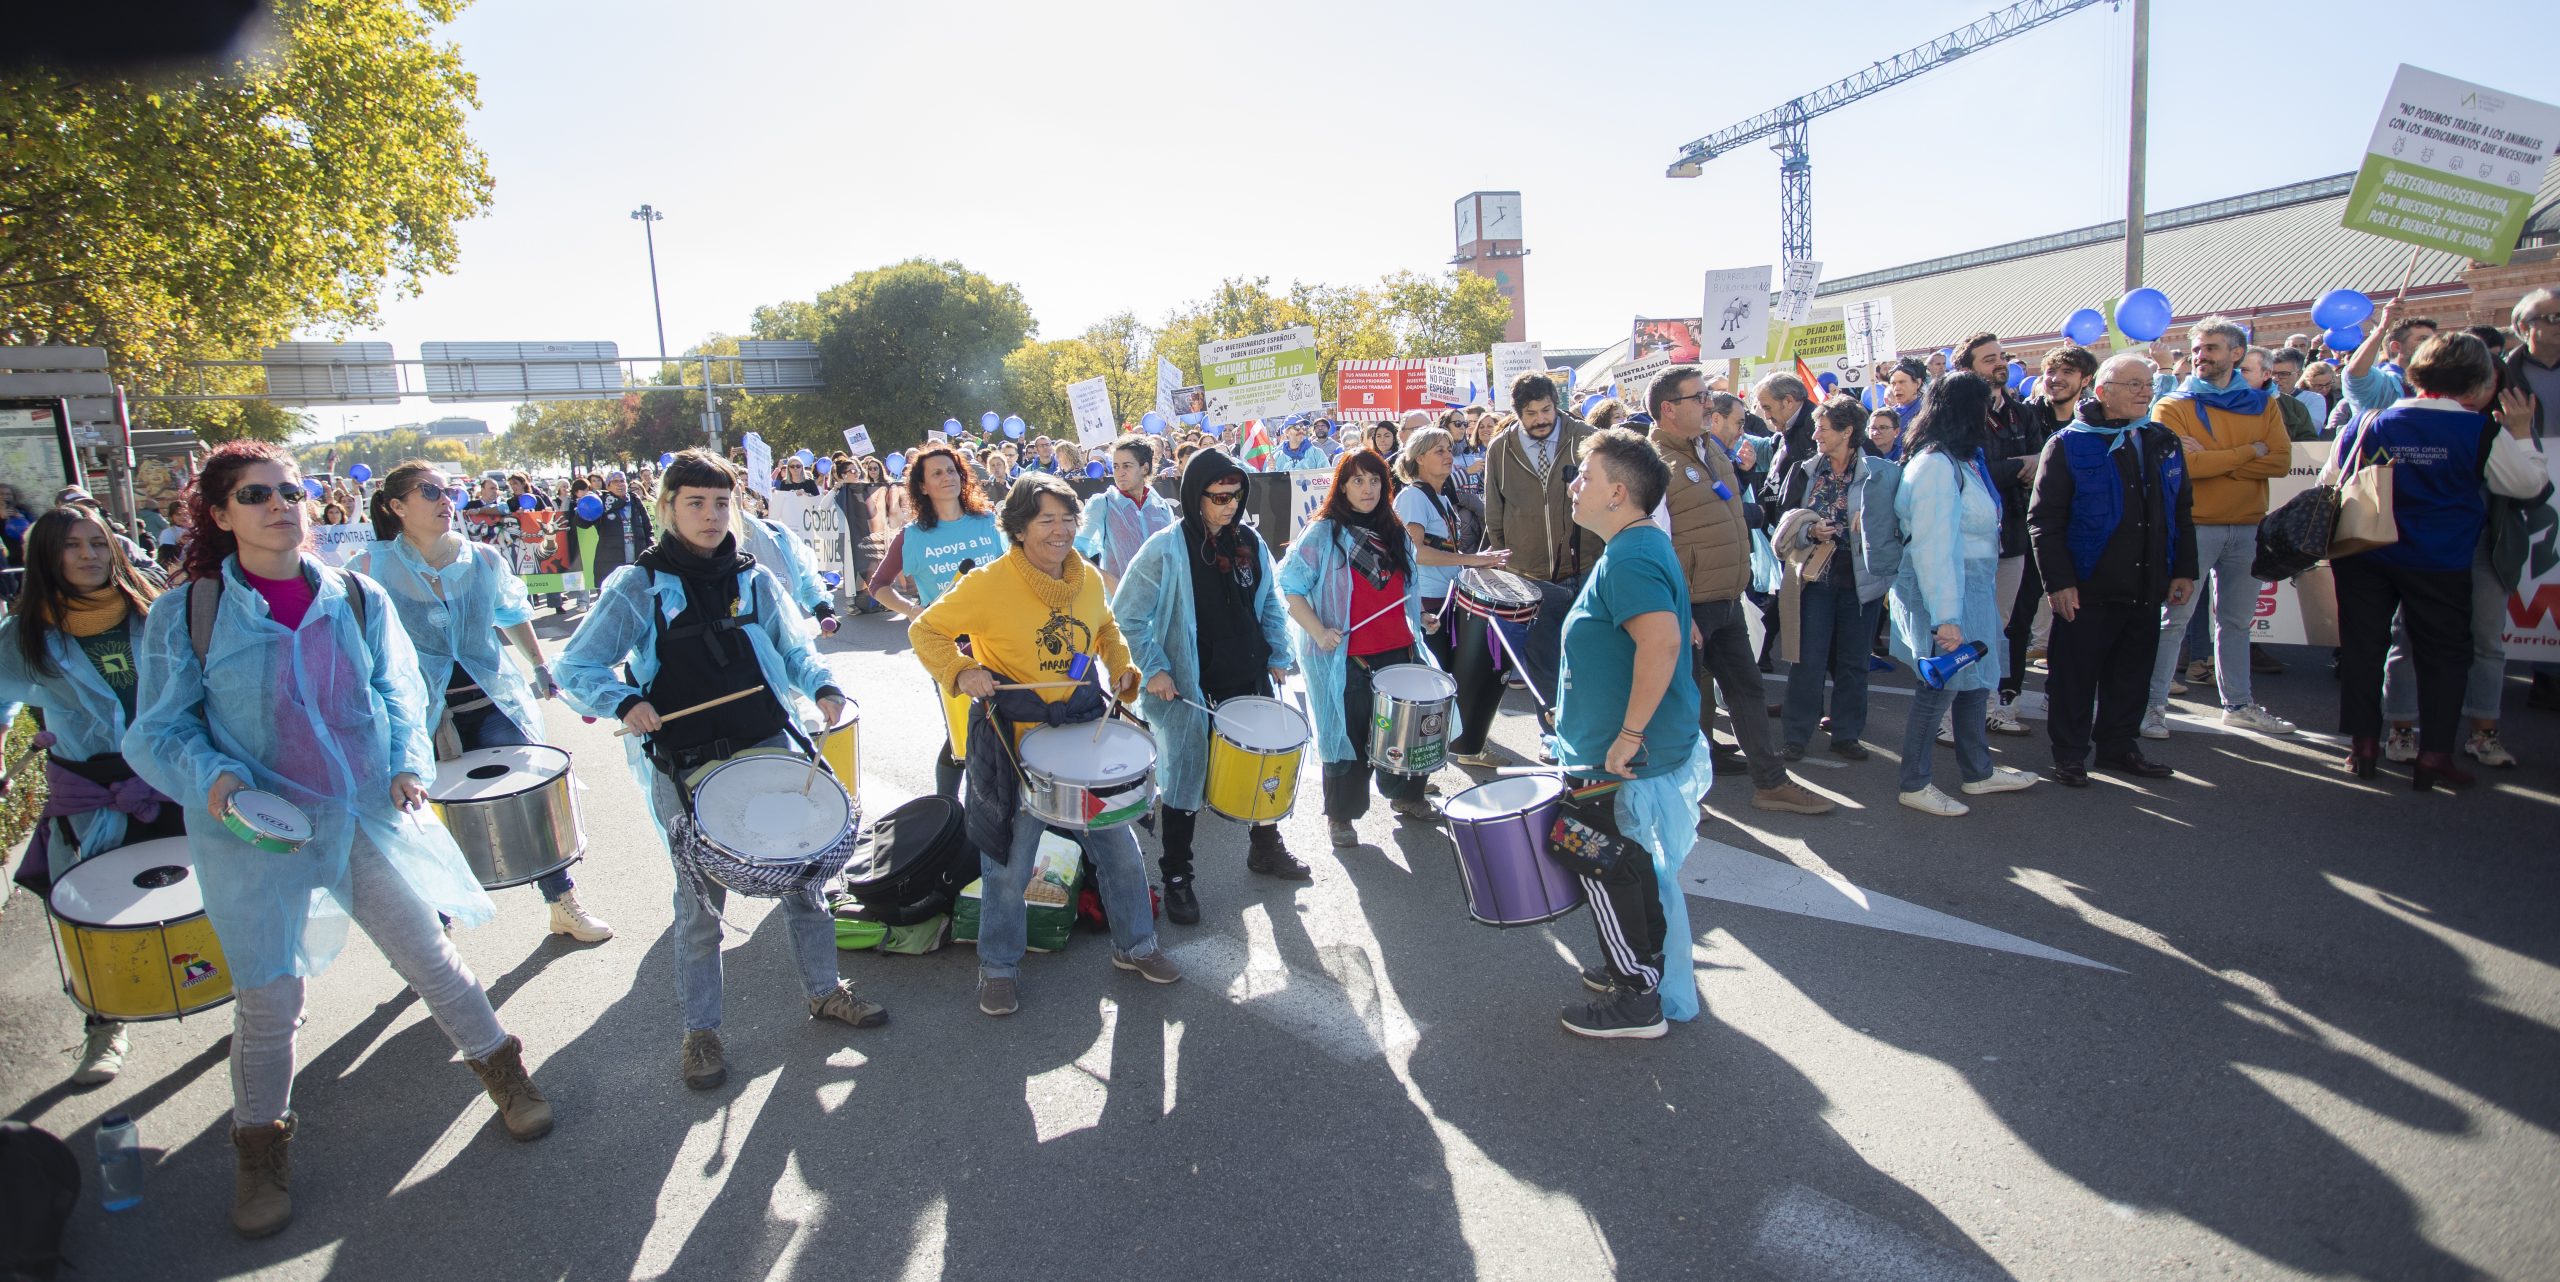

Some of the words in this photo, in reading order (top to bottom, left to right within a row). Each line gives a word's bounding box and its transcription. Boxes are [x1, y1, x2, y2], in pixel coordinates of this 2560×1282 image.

[2388, 117, 2406, 131] CON
[2407, 122, 2422, 135] LOS
[2422, 127, 2481, 151] MEDICAMENTOS
[2480, 141, 2497, 154] QUE
[2415, 107, 2453, 127] PODEMOS
[2452, 116, 2482, 134] TRATAR
[2482, 125, 2489, 135] A
[2489, 127, 2504, 140] LOS
[2504, 131, 2543, 150] ANIMALES
[2376, 192, 2393, 208] POR
[2396, 197, 2443, 219] NUESTROS
[2443, 208, 2491, 231] PACIENTES
[2491, 221, 2500, 232] Y
[2368, 210, 2387, 225] POR
[2388, 215, 2399, 228] EL
[2400, 217, 2450, 240] BIENESTAR
[2449, 229, 2460, 242] DE
[2460, 231, 2493, 250] TODOS
[1806, 325, 1828, 336] DEJAD
[1830, 323, 1844, 332] QUE
[1214, 346, 1224, 354] LOS
[1267, 332, 1297, 344] ESPAÑOLES
[1230, 351, 1247, 359] DEBEN
[1248, 348, 1266, 356] ELEGIR
[1266, 344, 1283, 354] ENTRE
[1794, 337, 1808, 347] LOS
[1797, 345, 1834, 356] SALVEMOS
[1214, 362, 1247, 377] SALVAR
[1249, 356, 1276, 370] VIDAS
[1236, 368, 1276, 384] VULNERAR
[1278, 367, 1288, 378] LA
[1289, 364, 1304, 375] LEY
[1429, 366, 1438, 374] LA
[1440, 366, 1456, 377] SALUD
[1614, 366, 1646, 380] NUESTRA
[1646, 360, 1670, 370] SALUD
[1429, 384, 1454, 396] ESPERAR
[1438, 376, 1456, 386] PUEDE
[334, 532, 364, 544] CONTRA
[365, 530, 374, 542] EL
[925, 542, 966, 558] Apoya
[969, 540, 978, 548] a
[979, 536, 992, 546] tu
[929, 553, 995, 575] Veterario
